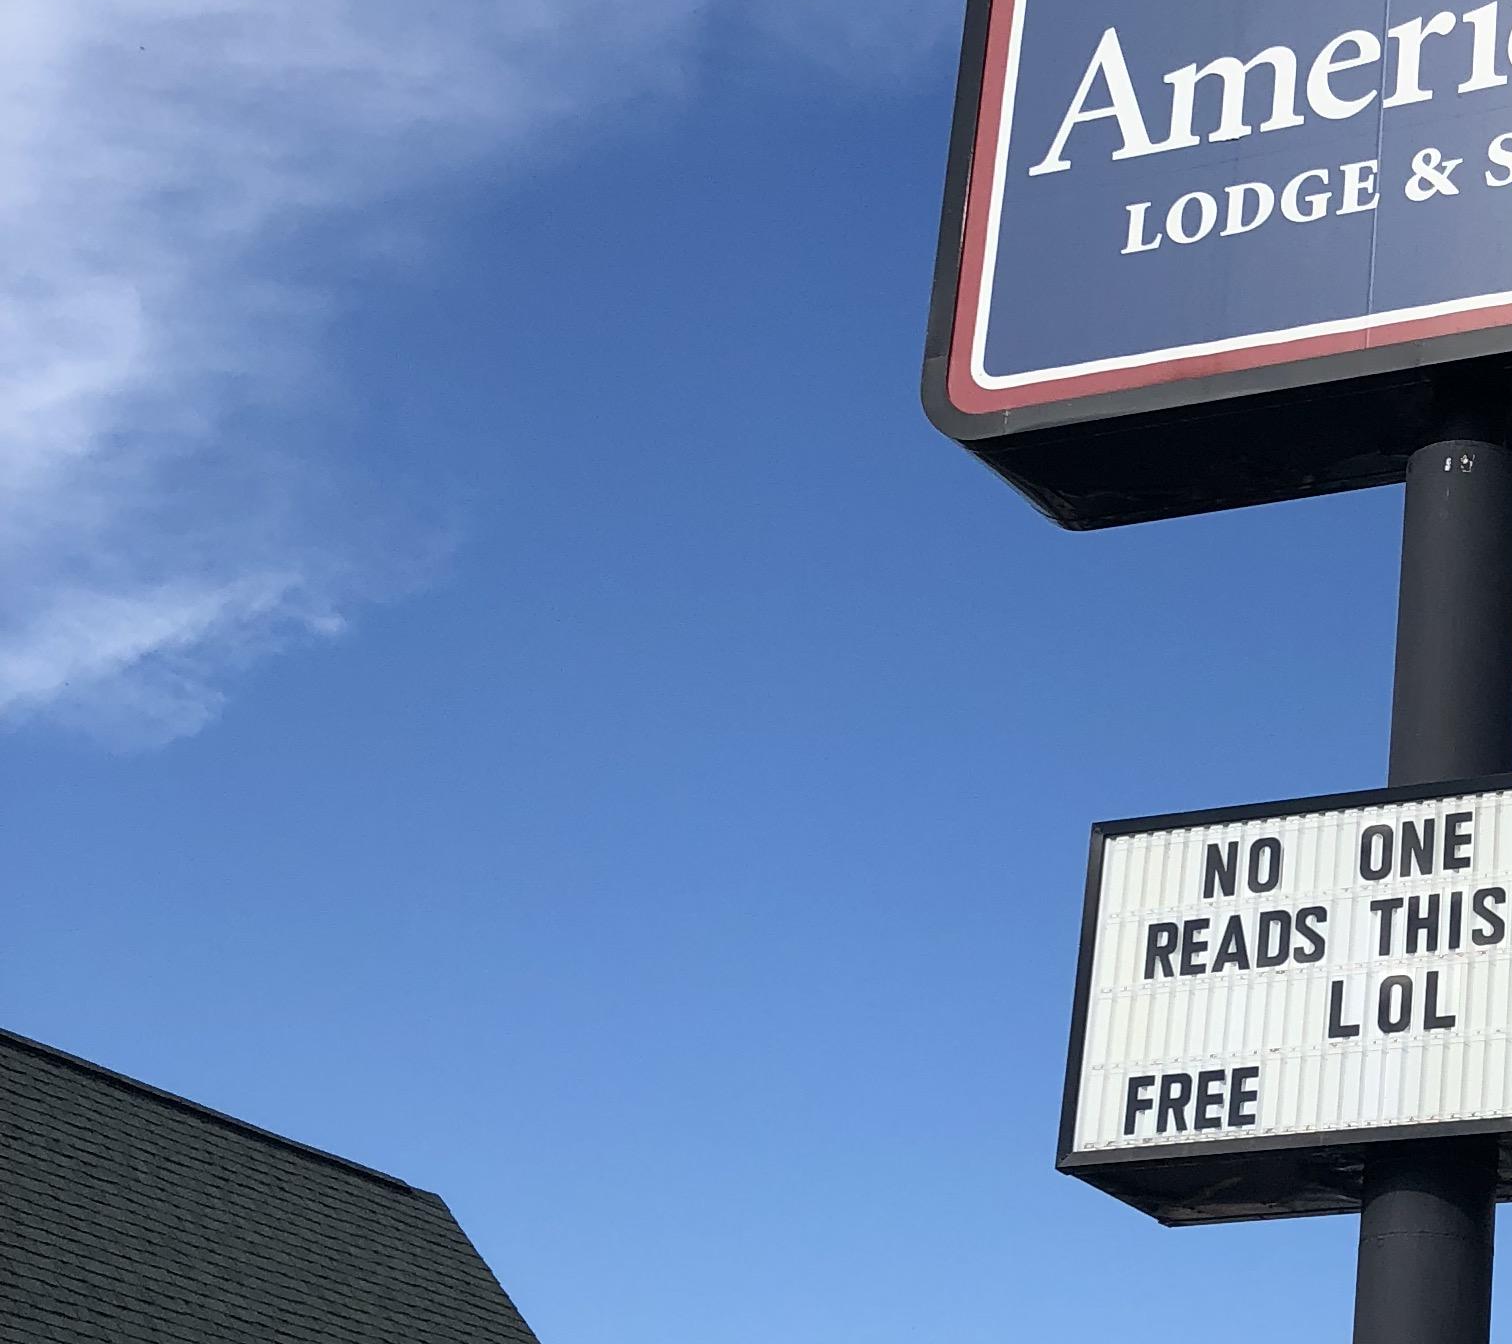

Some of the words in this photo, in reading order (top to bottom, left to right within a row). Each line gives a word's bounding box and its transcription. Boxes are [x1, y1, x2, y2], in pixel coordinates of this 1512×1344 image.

[1120, 159, 1380, 255] LODGE
[1404, 147, 1464, 202] &
[1203, 836, 1282, 899] NO
[1359, 811, 1473, 881] ONE
[1143, 905, 1328, 980] READS
[1370, 886, 1506, 957] THIS
[1328, 970, 1456, 1039] LOL
[1123, 1066, 1260, 1136] FREE
